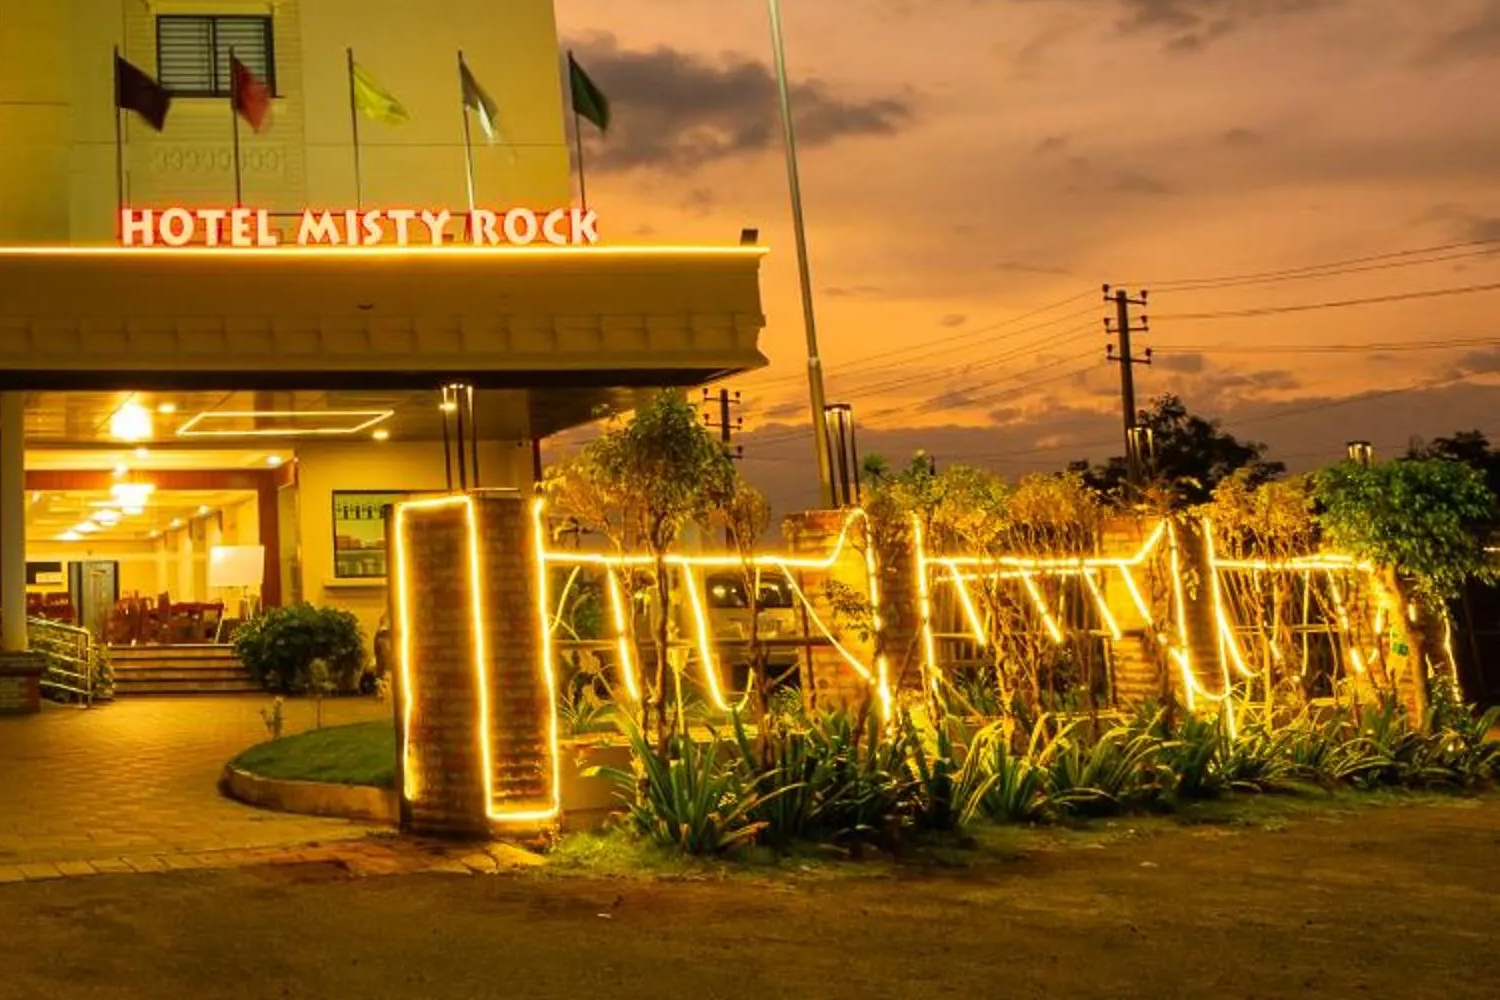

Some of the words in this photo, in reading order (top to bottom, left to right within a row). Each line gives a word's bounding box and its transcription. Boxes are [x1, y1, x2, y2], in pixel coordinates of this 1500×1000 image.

[120, 206, 278, 247] HOTEL
[297, 207, 451, 247] MISTY
[469, 206, 599, 247] ROCK
